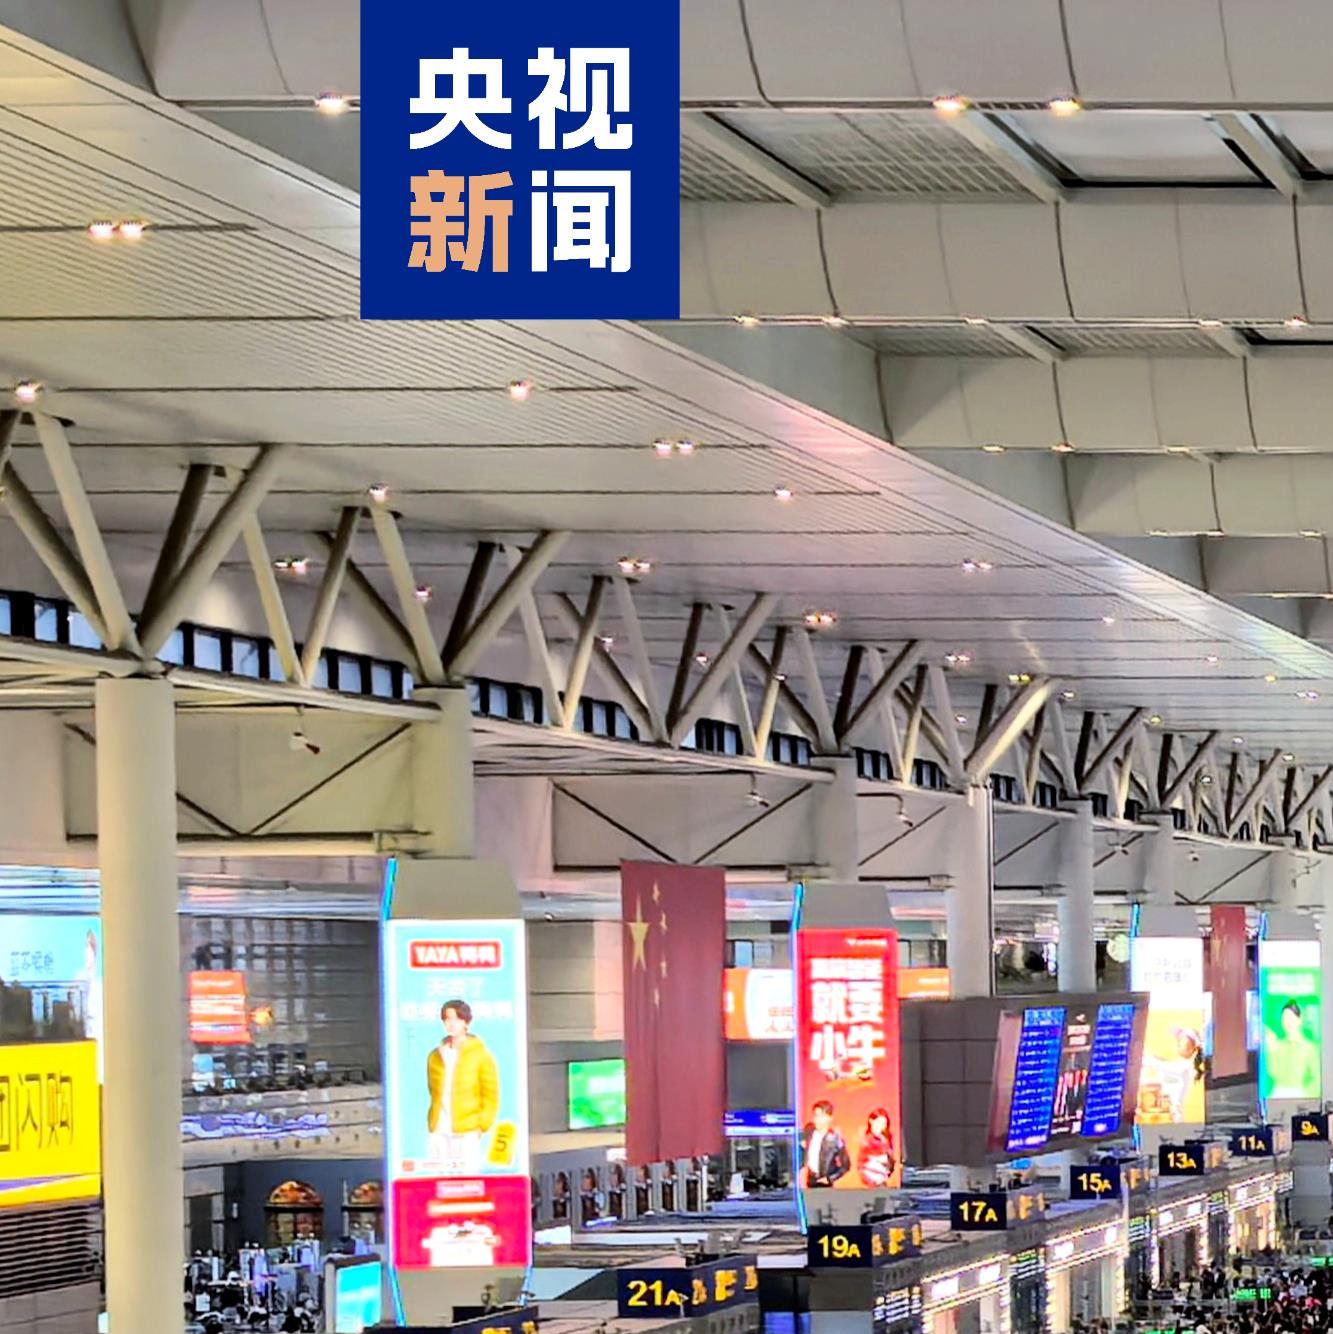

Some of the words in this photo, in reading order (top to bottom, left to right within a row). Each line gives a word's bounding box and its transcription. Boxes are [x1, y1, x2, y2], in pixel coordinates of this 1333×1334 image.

[1238, 1135, 1266, 1151] 11A
[1167, 1152, 1197, 1169] 13A
[1077, 1173, 1112, 1192] 15A
[959, 1201, 998, 1222] 17A
[818, 1235, 861, 1258] 19A
[627, 1280, 683, 1306] 21A
